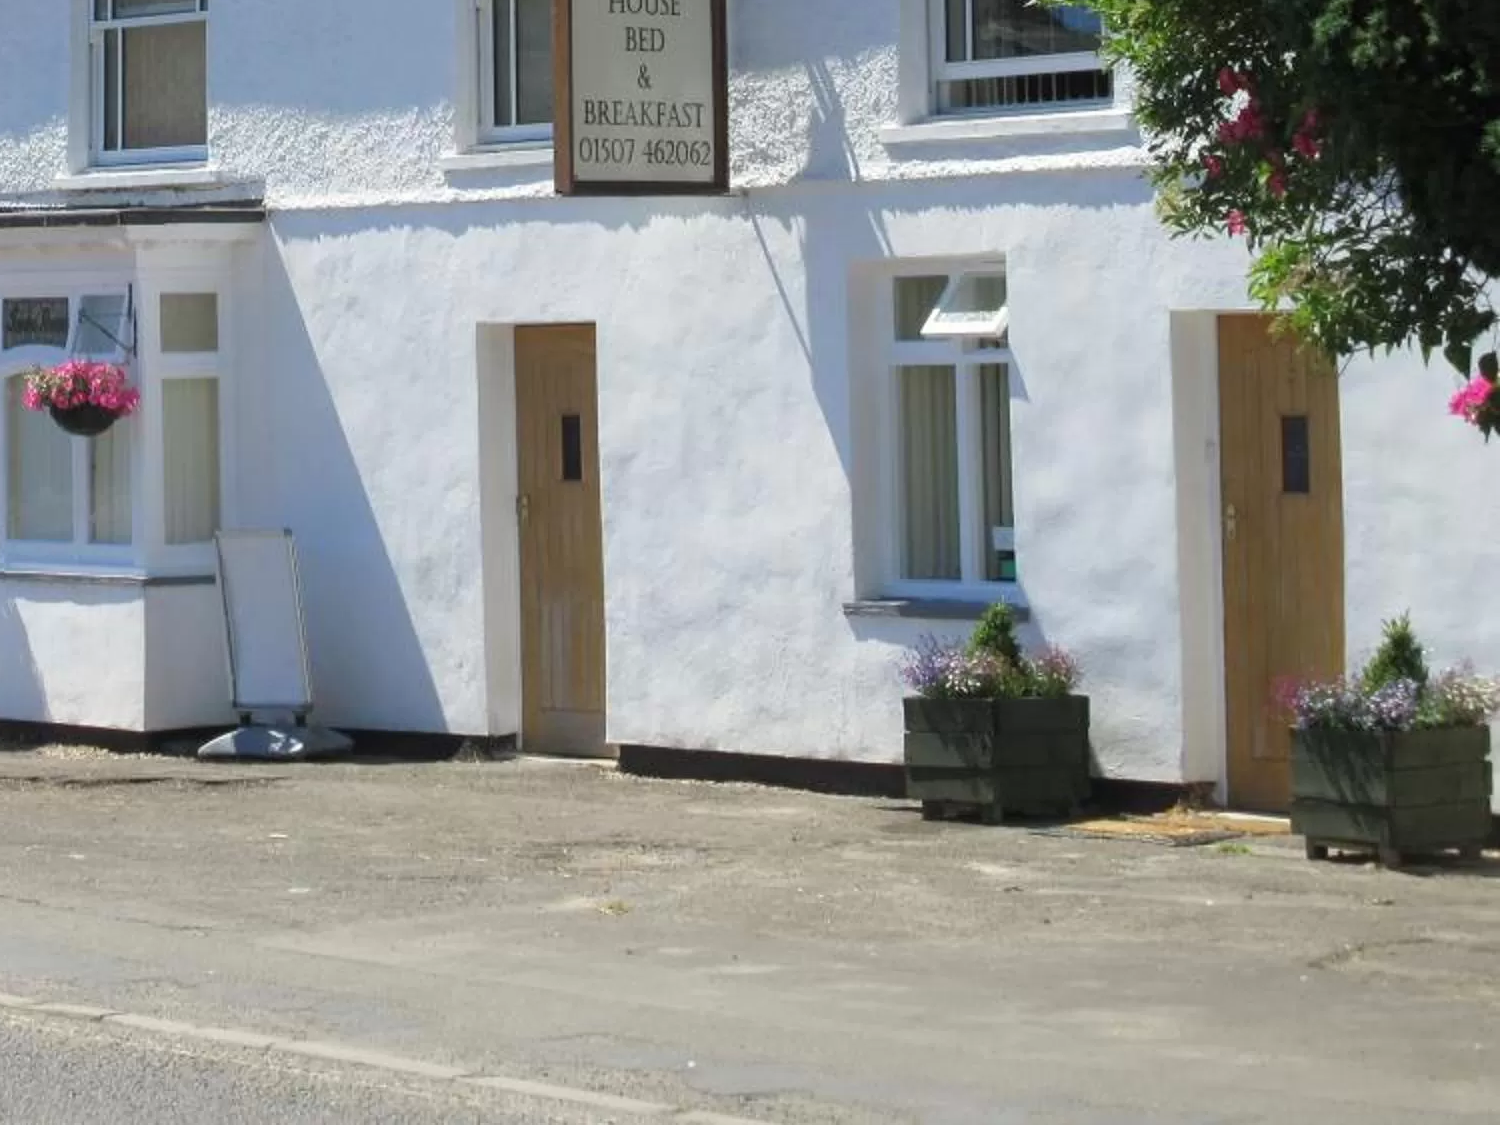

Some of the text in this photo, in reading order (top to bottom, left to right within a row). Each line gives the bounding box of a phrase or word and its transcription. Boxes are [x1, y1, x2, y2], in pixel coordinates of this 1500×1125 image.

[624, 26, 665, 53] BED
[636, 62, 652, 89] &
[583, 99, 704, 128] BREAKFAST
[579, 137, 711, 166] 01507 462062
